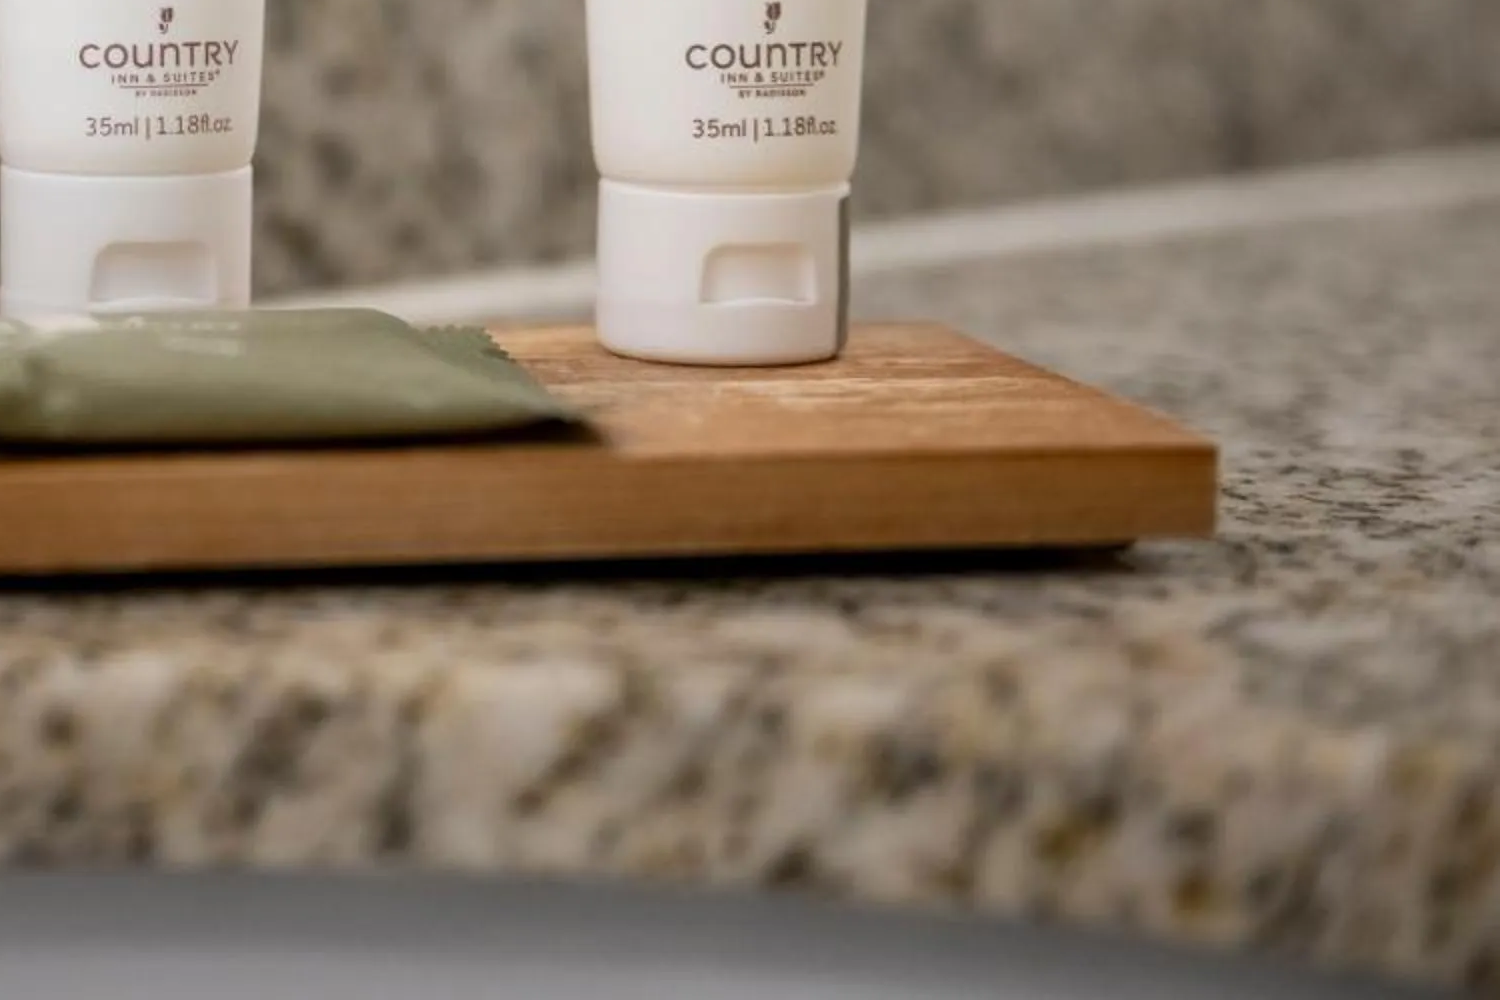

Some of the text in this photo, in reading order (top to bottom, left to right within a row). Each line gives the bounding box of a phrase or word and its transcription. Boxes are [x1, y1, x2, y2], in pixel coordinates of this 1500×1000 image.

[110, 72, 140, 85] INN
[719, 72, 749, 85] INN
[85, 115, 140, 137] 35ml
[692, 117, 747, 139] 35ml
